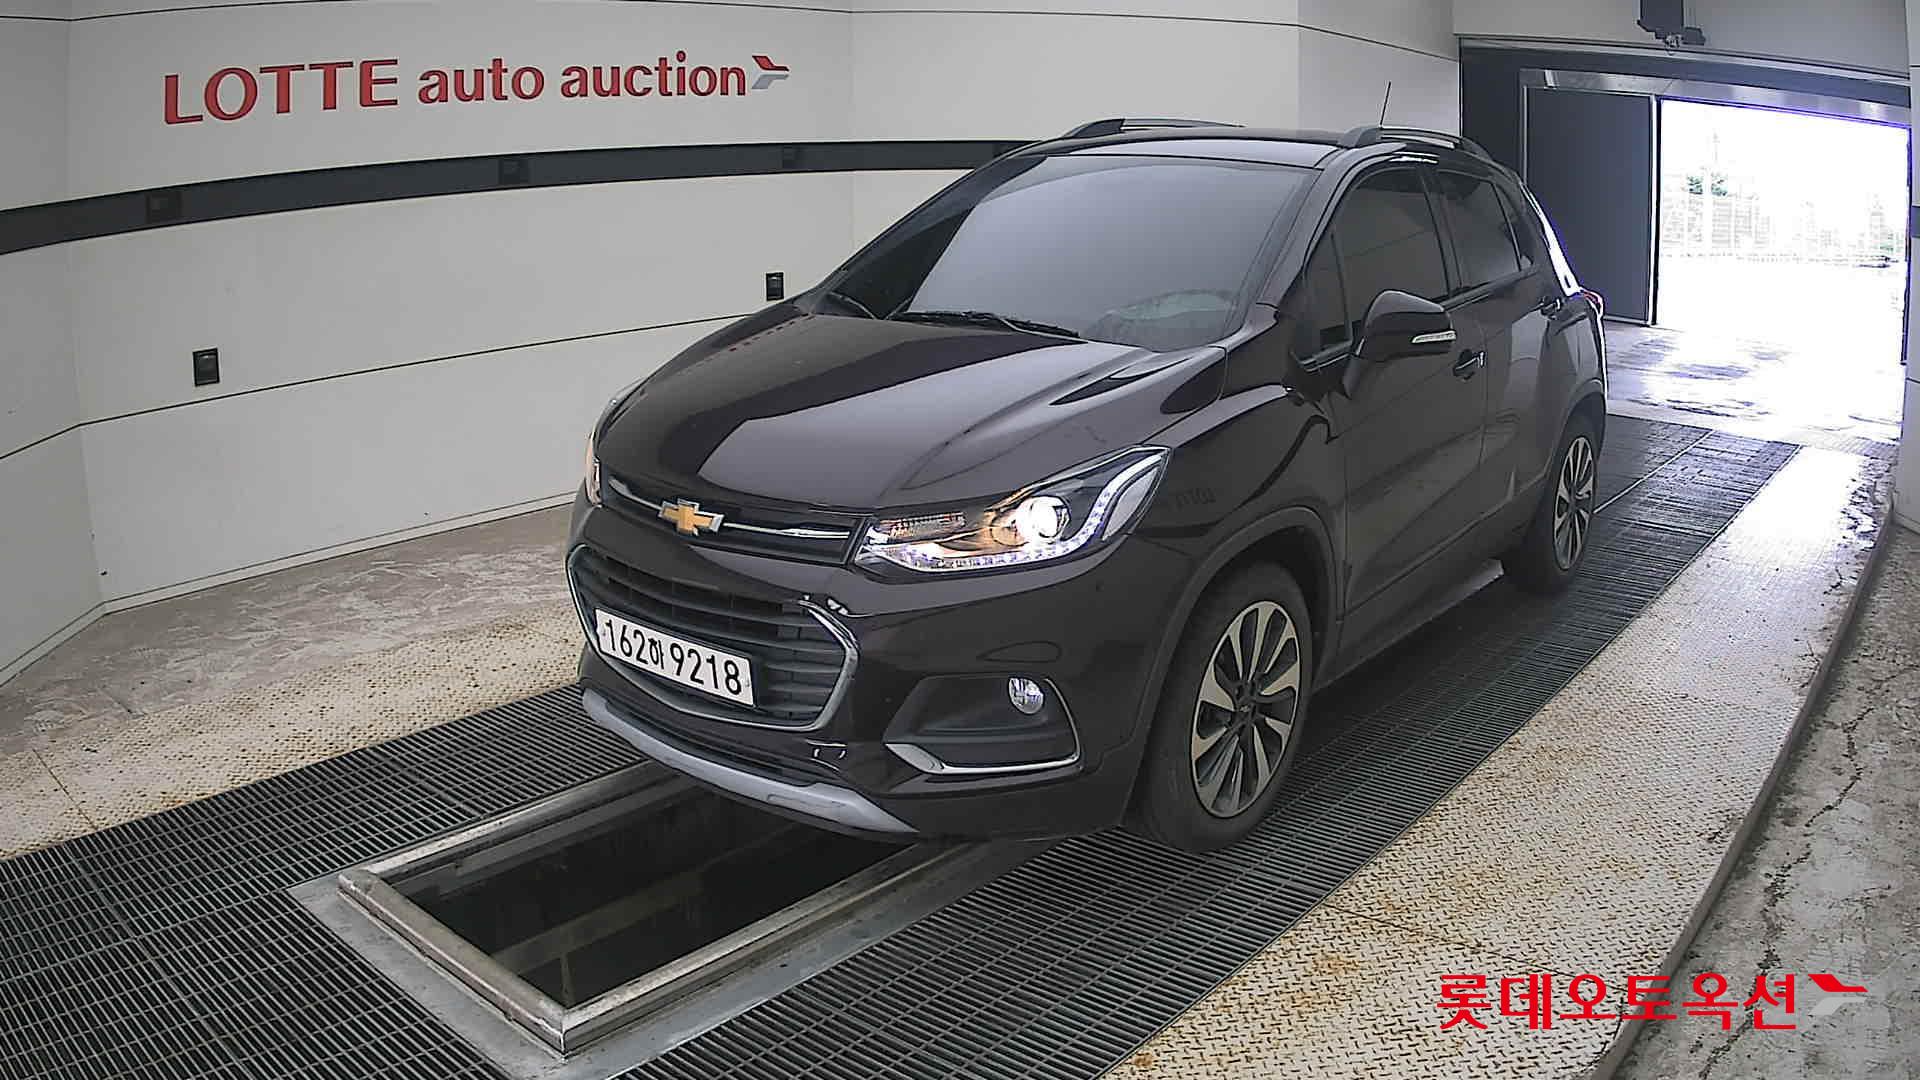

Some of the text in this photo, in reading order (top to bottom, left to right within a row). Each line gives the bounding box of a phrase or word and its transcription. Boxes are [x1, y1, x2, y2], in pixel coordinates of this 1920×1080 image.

[163, 50, 747, 125] LOTTE auto auction
